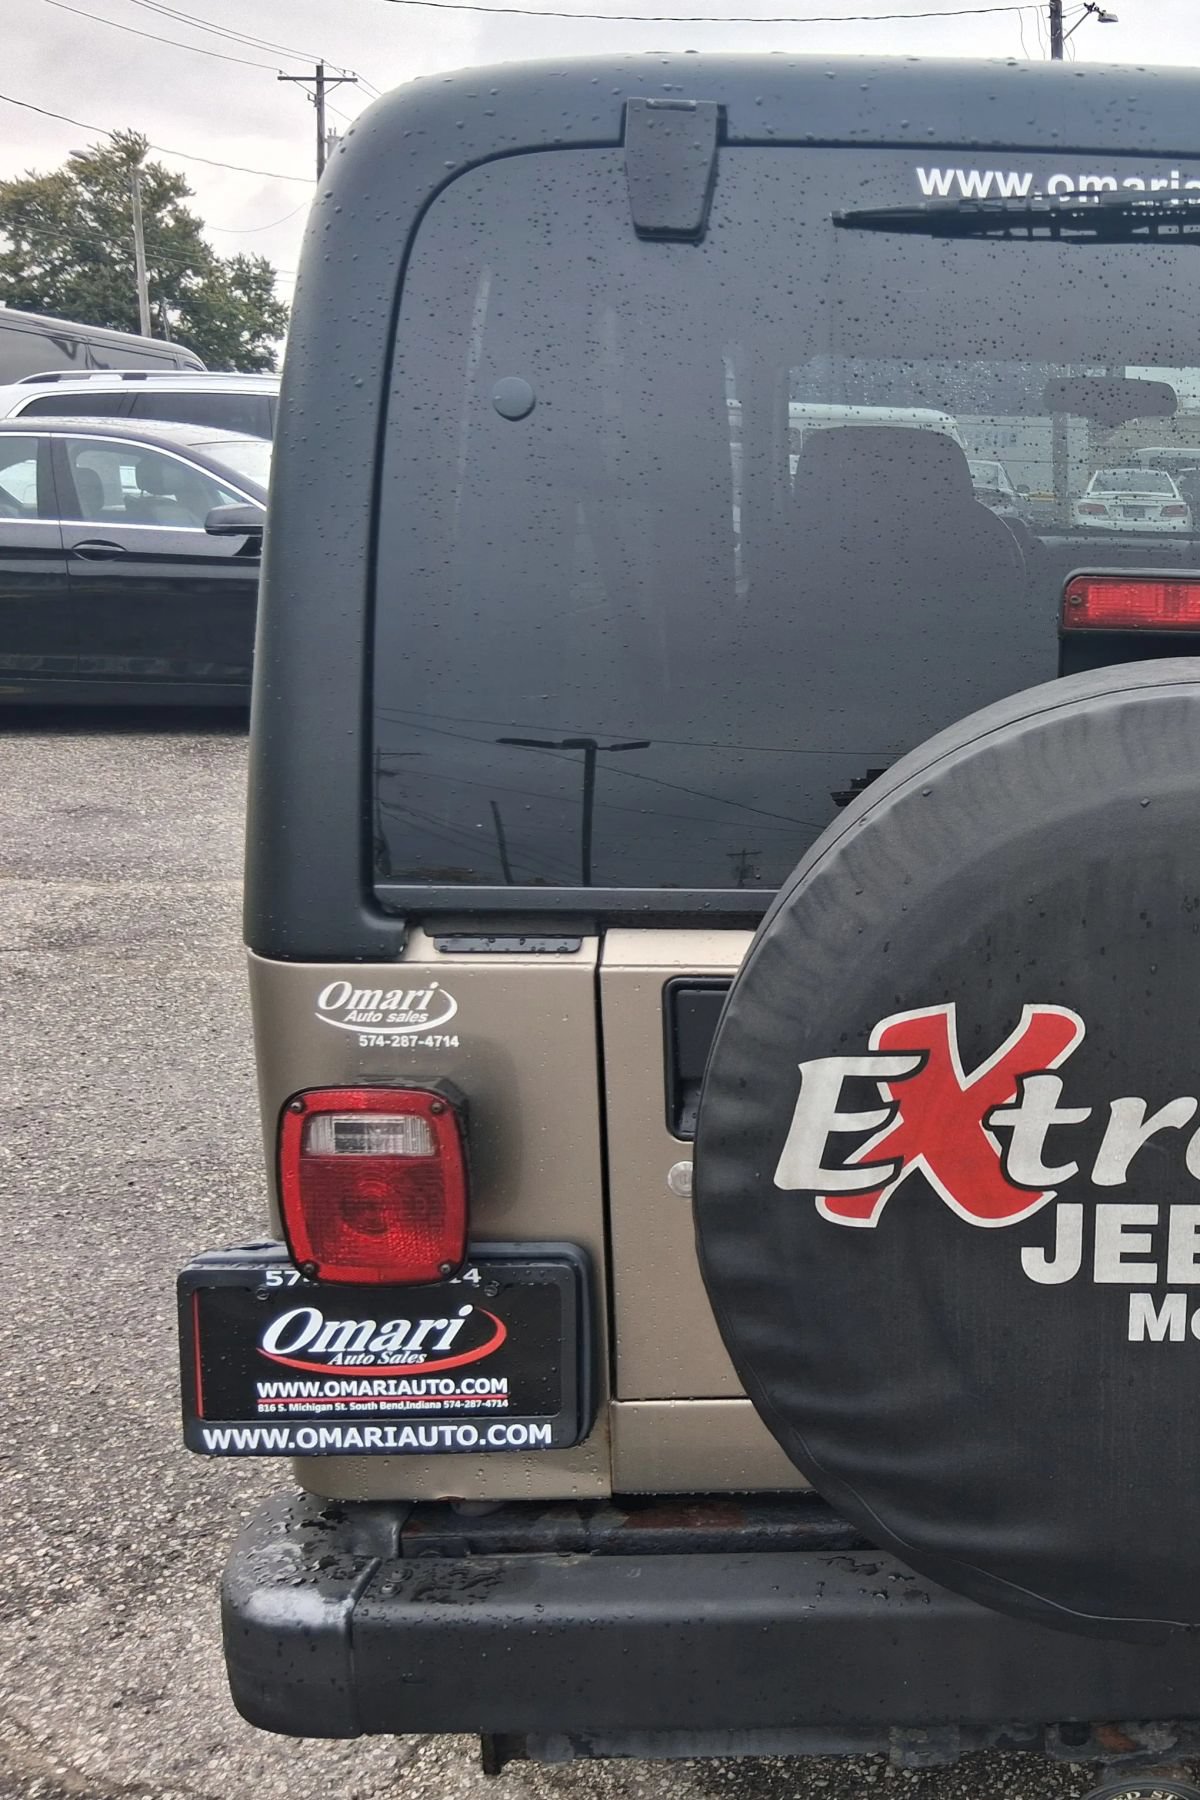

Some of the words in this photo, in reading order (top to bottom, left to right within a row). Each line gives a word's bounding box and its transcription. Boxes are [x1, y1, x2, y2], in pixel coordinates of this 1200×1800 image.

[318, 981, 439, 1010] Omari
[343, 1010, 383, 1023] Auto
[386, 1010, 429, 1023] sales
[359, 1035, 460, 1047] 574-287-4714
[262, 1304, 474, 1355] Omari
[328, 1352, 374, 1366] Auto
[377, 1350, 427, 1365] Sales
[257, 1378, 508, 1398] WWW.OMARIAUTO.COM
[257, 1403, 277, 1412] 816
[289, 1402, 333, 1413] Michigan
[335, 1402, 348, 1411] St.
[349, 1401, 378, 1411] South
[443, 1399, 509, 1409] 574-287-4714
[203, 1424, 553, 1450] WWW.OMARIAUTO.COM
